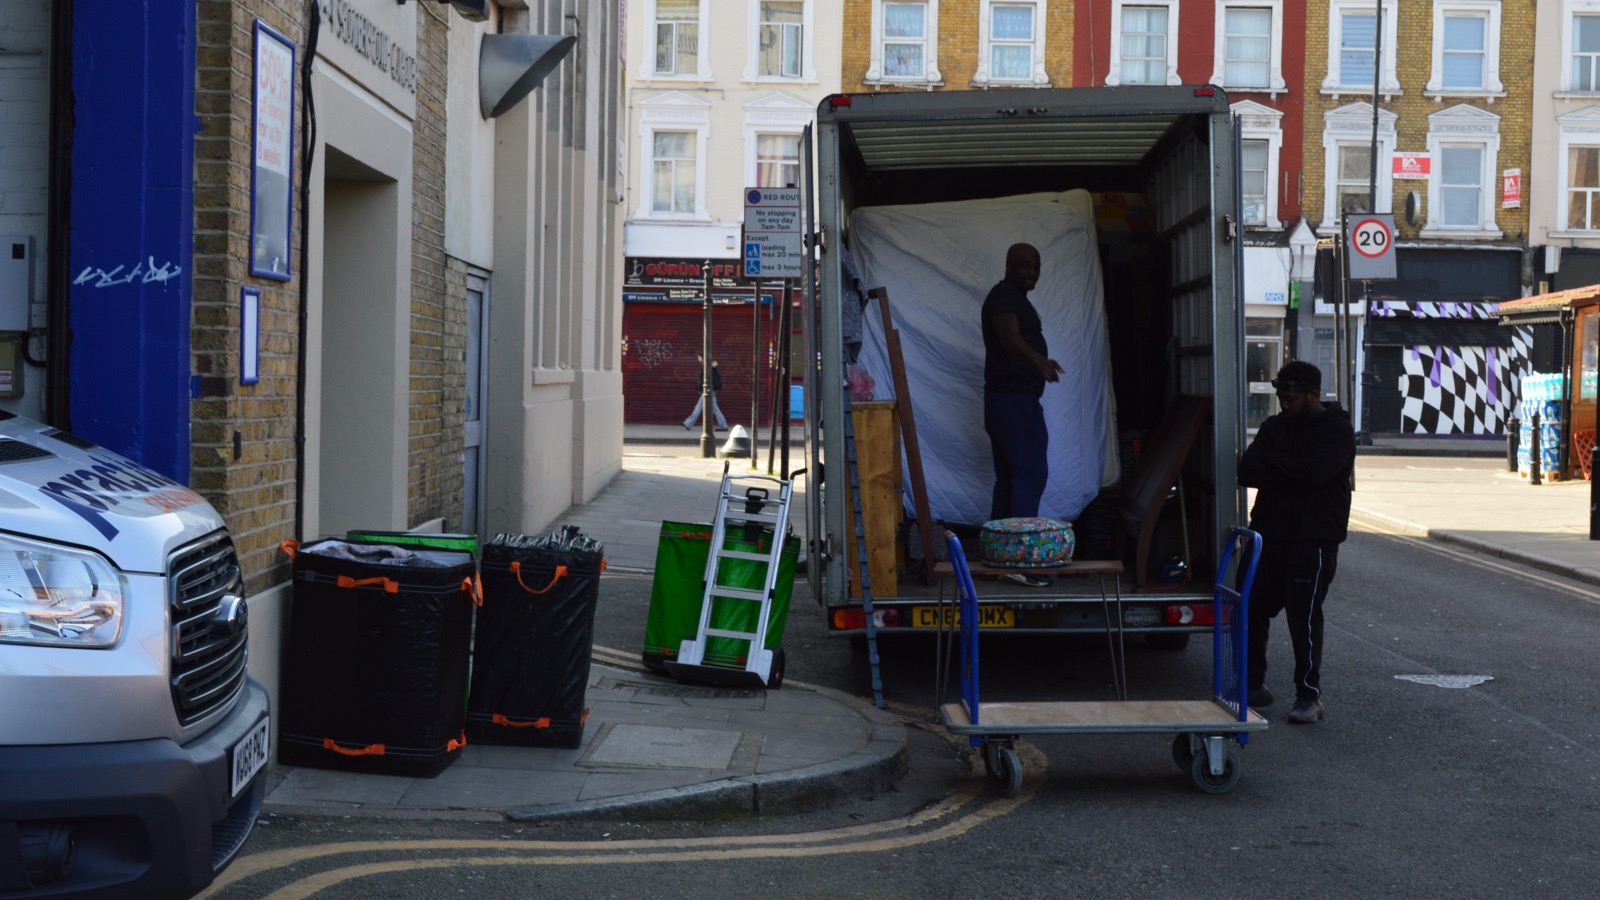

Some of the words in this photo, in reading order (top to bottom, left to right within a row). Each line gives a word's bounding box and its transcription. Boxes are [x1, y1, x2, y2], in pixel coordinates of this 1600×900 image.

[259, 45, 289, 101] 50%
[258, 120, 268, 138] for
[1359, 230, 1386, 246] 20
[645, 261, 701, 277] GÜRÜN
[711, 264, 734, 277] FF
[1265, 293, 1284, 301] NHS
